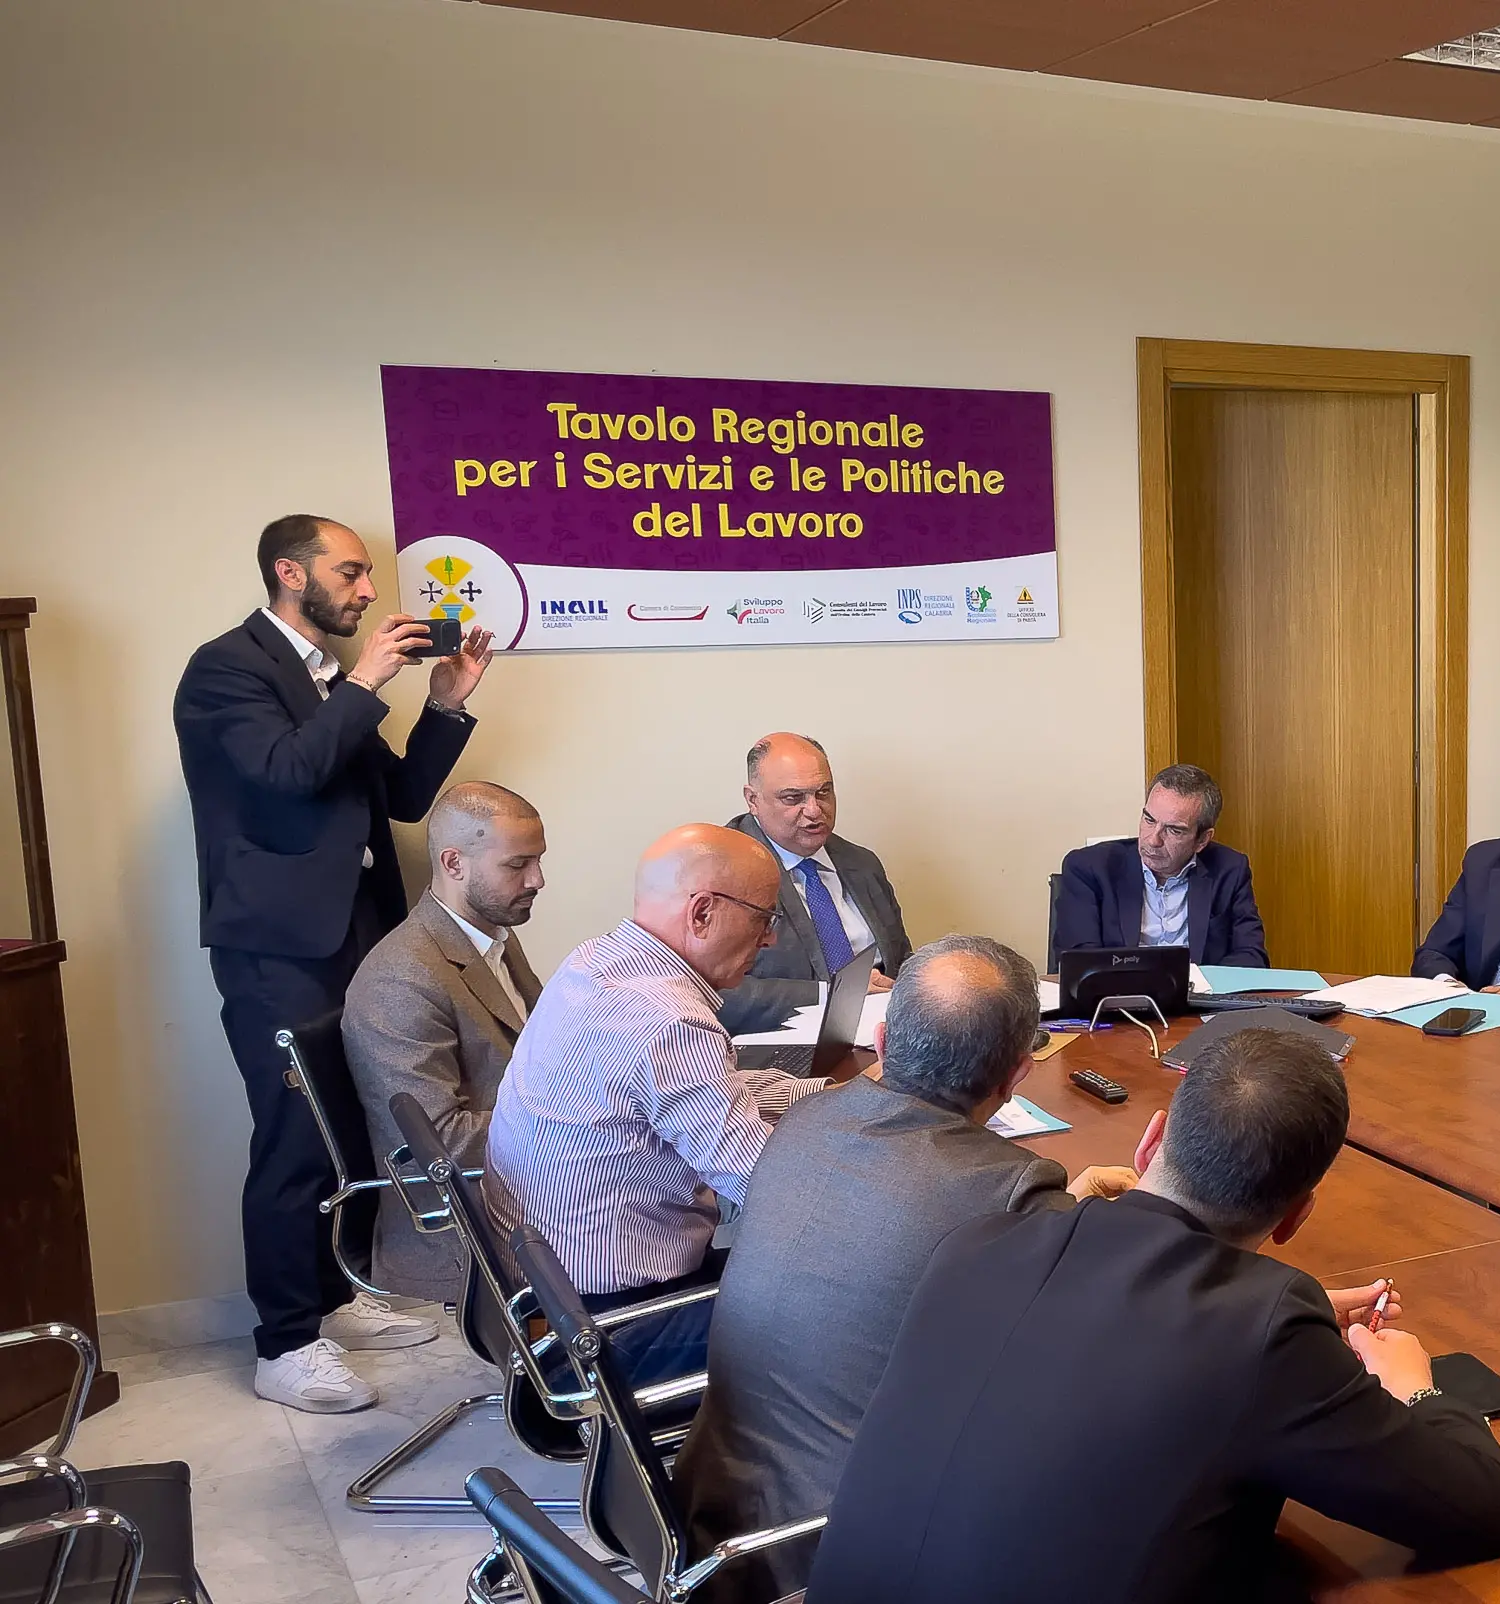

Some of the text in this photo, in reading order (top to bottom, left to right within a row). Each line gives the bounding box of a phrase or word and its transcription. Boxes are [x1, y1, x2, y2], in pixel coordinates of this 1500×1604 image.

[546, 402, 925, 455] Tavolo Regionale
[454, 451, 1005, 497] per i Servizi e le Politiche
[632, 502, 864, 538] del Lavoro
[541, 600, 608, 614] INAIL
[743, 597, 783, 607] Sviluppo
[897, 588, 922, 609] INPS
[747, 616, 770, 624] Italia
[1123, 955, 1140, 963] poly
